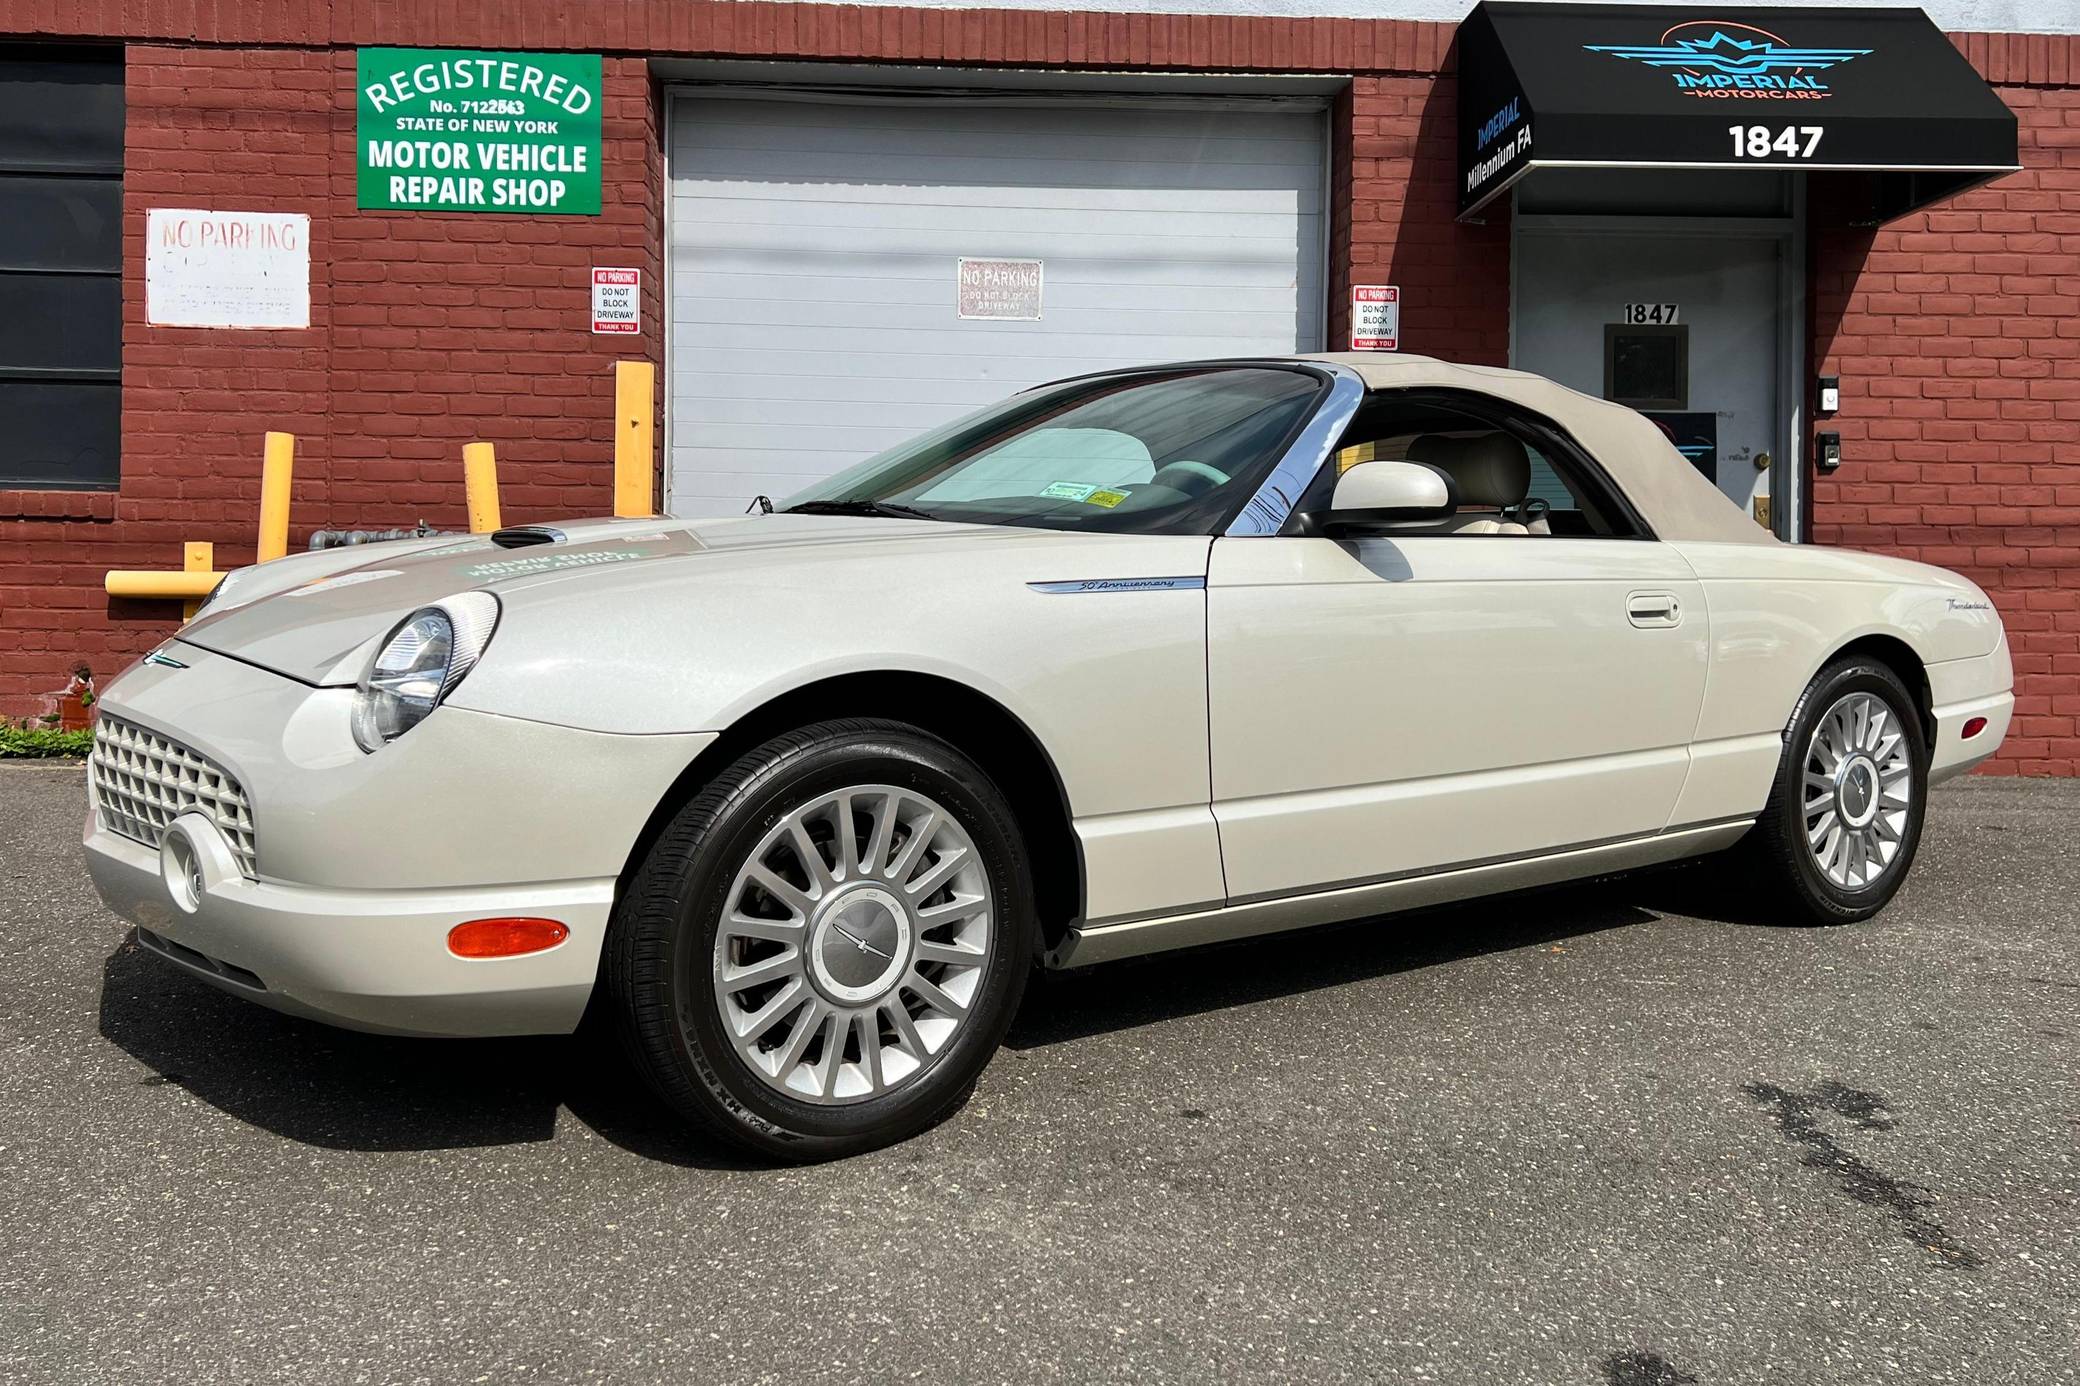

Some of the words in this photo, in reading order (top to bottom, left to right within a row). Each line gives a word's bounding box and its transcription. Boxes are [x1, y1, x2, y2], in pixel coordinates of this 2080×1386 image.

[365, 60, 592, 114] REGISTERED
[430, 100, 457, 113] No.
[396, 117, 444, 131] STATE
[448, 119, 469, 131] OF
[473, 119, 511, 133] NEW
[514, 120, 558, 134] YORK
[1477, 96, 1520, 151] IMPERIAL
[1729, 125, 1824, 158] 1847
[368, 140, 471, 169] MOTOR
[476, 143, 587, 172] VEHICLE
[1467, 141, 1515, 193] Millennium
[1517, 124, 1532, 154] FA
[390, 175, 485, 204] REPAIR
[492, 179, 566, 207] SHOP
[163, 220, 192, 248] NO
[597, 271, 607, 282] NO
[608, 272, 635, 283] PARKING
[963, 271, 979, 285] NO
[985, 271, 1037, 286] PARKING
[602, 288, 613, 296] DO
[614, 288, 629, 296] NOT
[1358, 289, 1367, 300] NO
[1368, 290, 1394, 300] PARKING
[603, 299, 628, 307] BLOCK
[1362, 305, 1373, 313] DO
[1374, 305, 1388, 313] NOT
[597, 310, 634, 319] DRIVEWAY
[1363, 316, 1387, 324] BLOCK
[1625, 304, 1677, 324] 1847
[1357, 327, 1393, 335] DRIVEWAY
[1097, 580, 1175, 589] Anniversary
